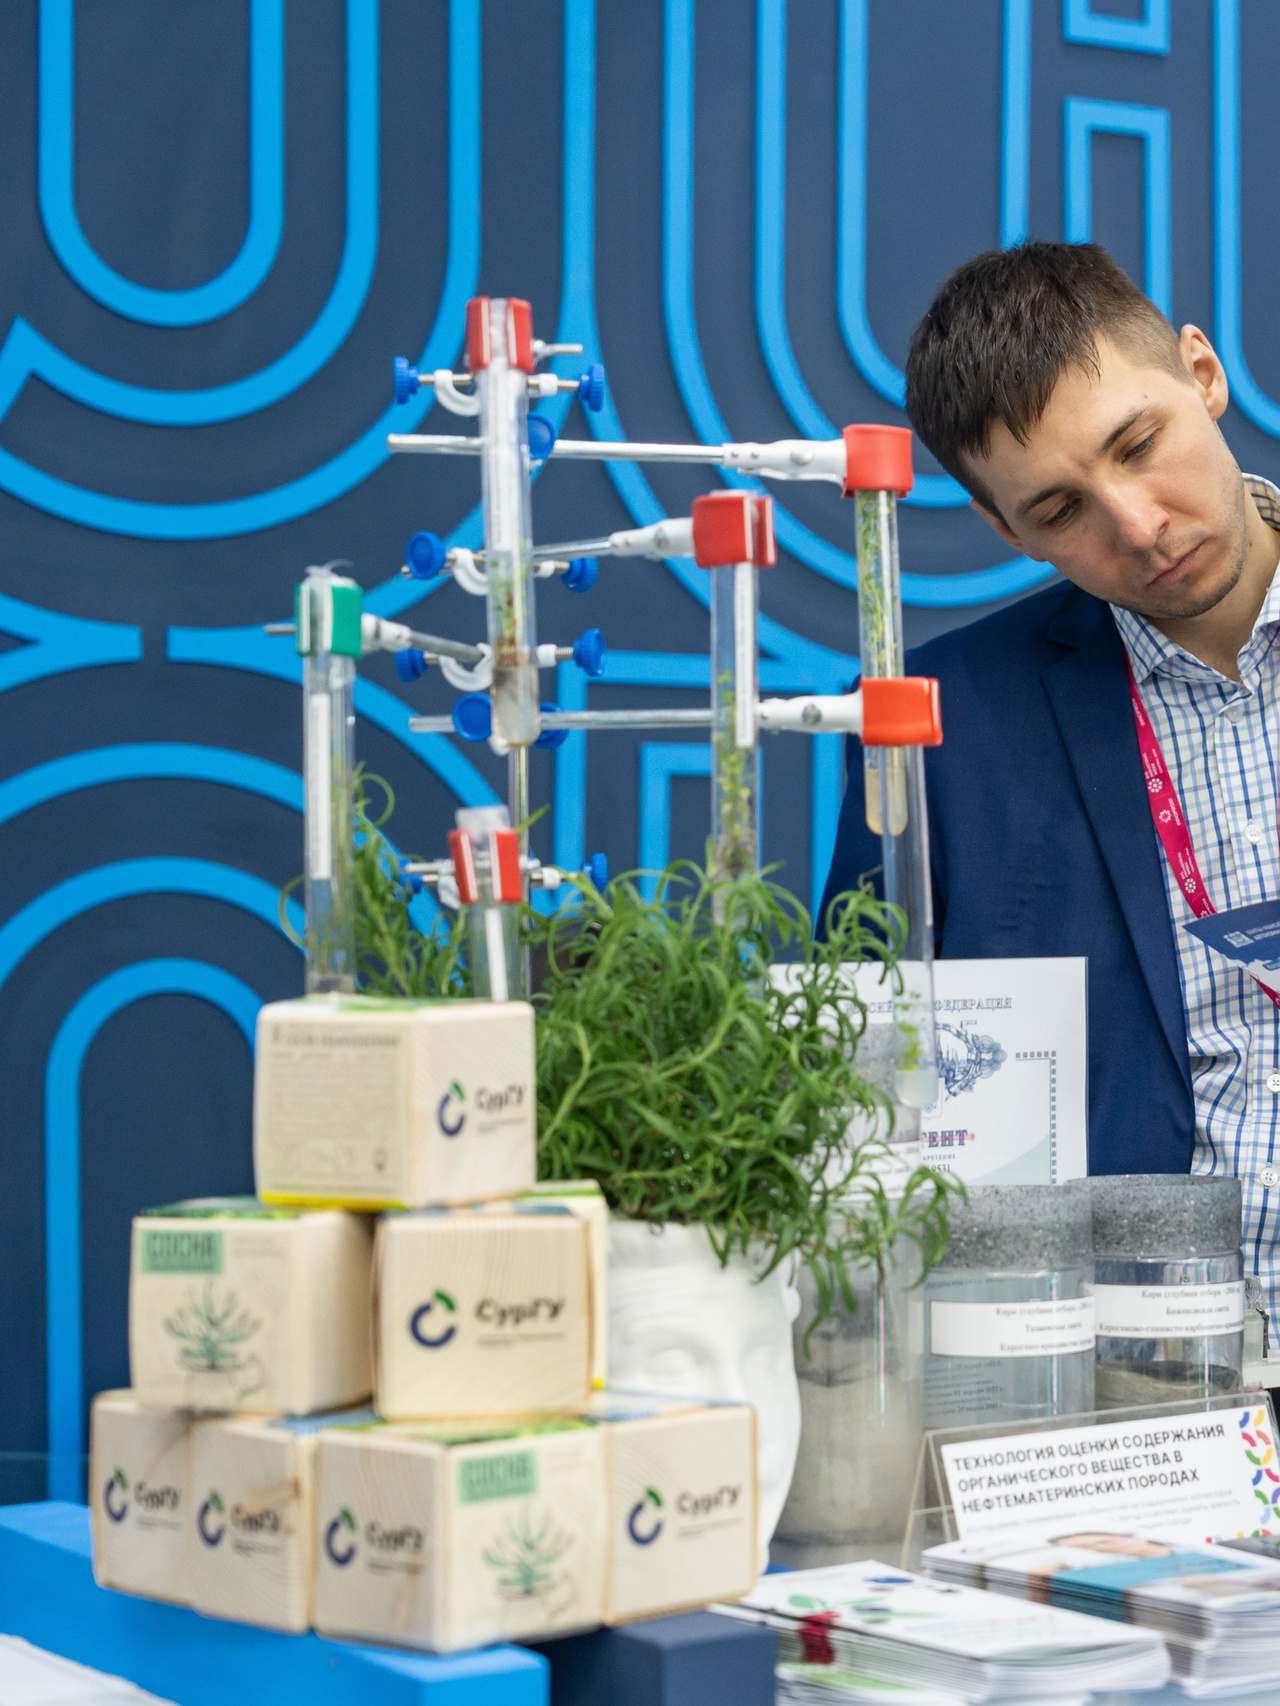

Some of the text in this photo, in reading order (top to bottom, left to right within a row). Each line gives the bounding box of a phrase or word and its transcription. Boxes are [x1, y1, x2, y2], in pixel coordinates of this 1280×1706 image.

[1168, 798, 1181, 827] INNOPROM
[933, 998, 1012, 1013] ФЕДЕРАЦИЯ
[921, 1129, 968, 1148] ЕНТ
[475, 1298, 566, 1325] СурГУ
[953, 1425, 1225, 1472] ТЕХНОЛОГИЯ ОЦЕНКИ СОДЕРЖАНИЯ
[958, 1451, 1183, 1492] ОРГАНИЧЕСКОГО ВЕЩЕСТВА В
[962, 1469, 1200, 1513] НЕФТЕМАТЕРИНСКИХ ПОРОДАХ
